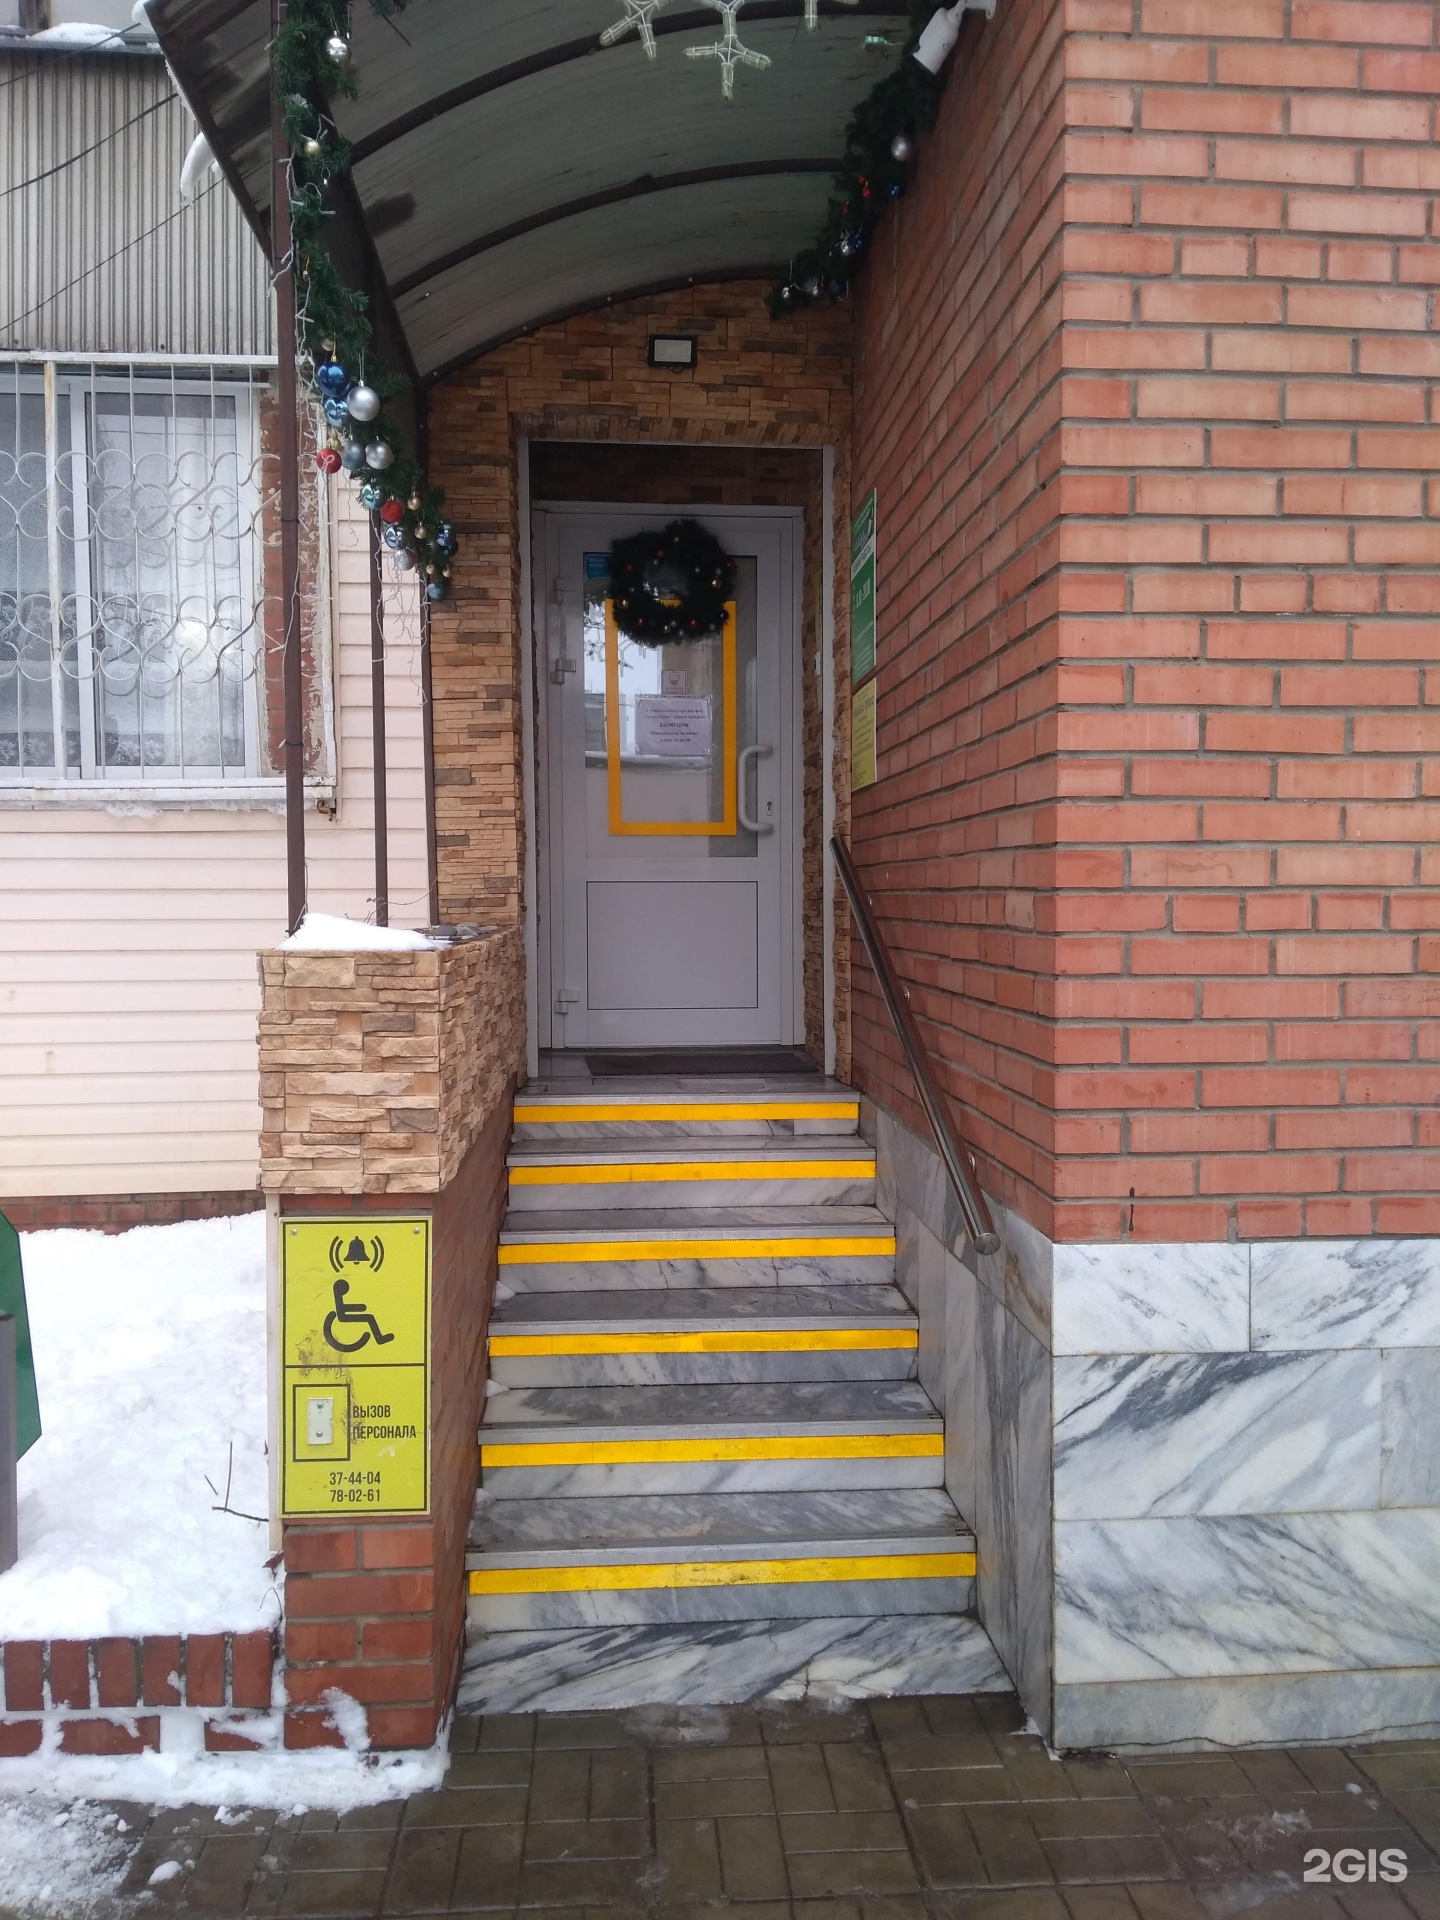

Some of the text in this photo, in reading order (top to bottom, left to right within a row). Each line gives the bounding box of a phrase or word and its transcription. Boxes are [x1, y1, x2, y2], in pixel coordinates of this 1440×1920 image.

[352, 1405, 391, 1418] ВЫЗОВ
[352, 1425, 417, 1439] ПЕРСОНАЛА
[329, 1471, 381, 1485] 37-44-04
[330, 1489, 381, 1502] 78-02-61
